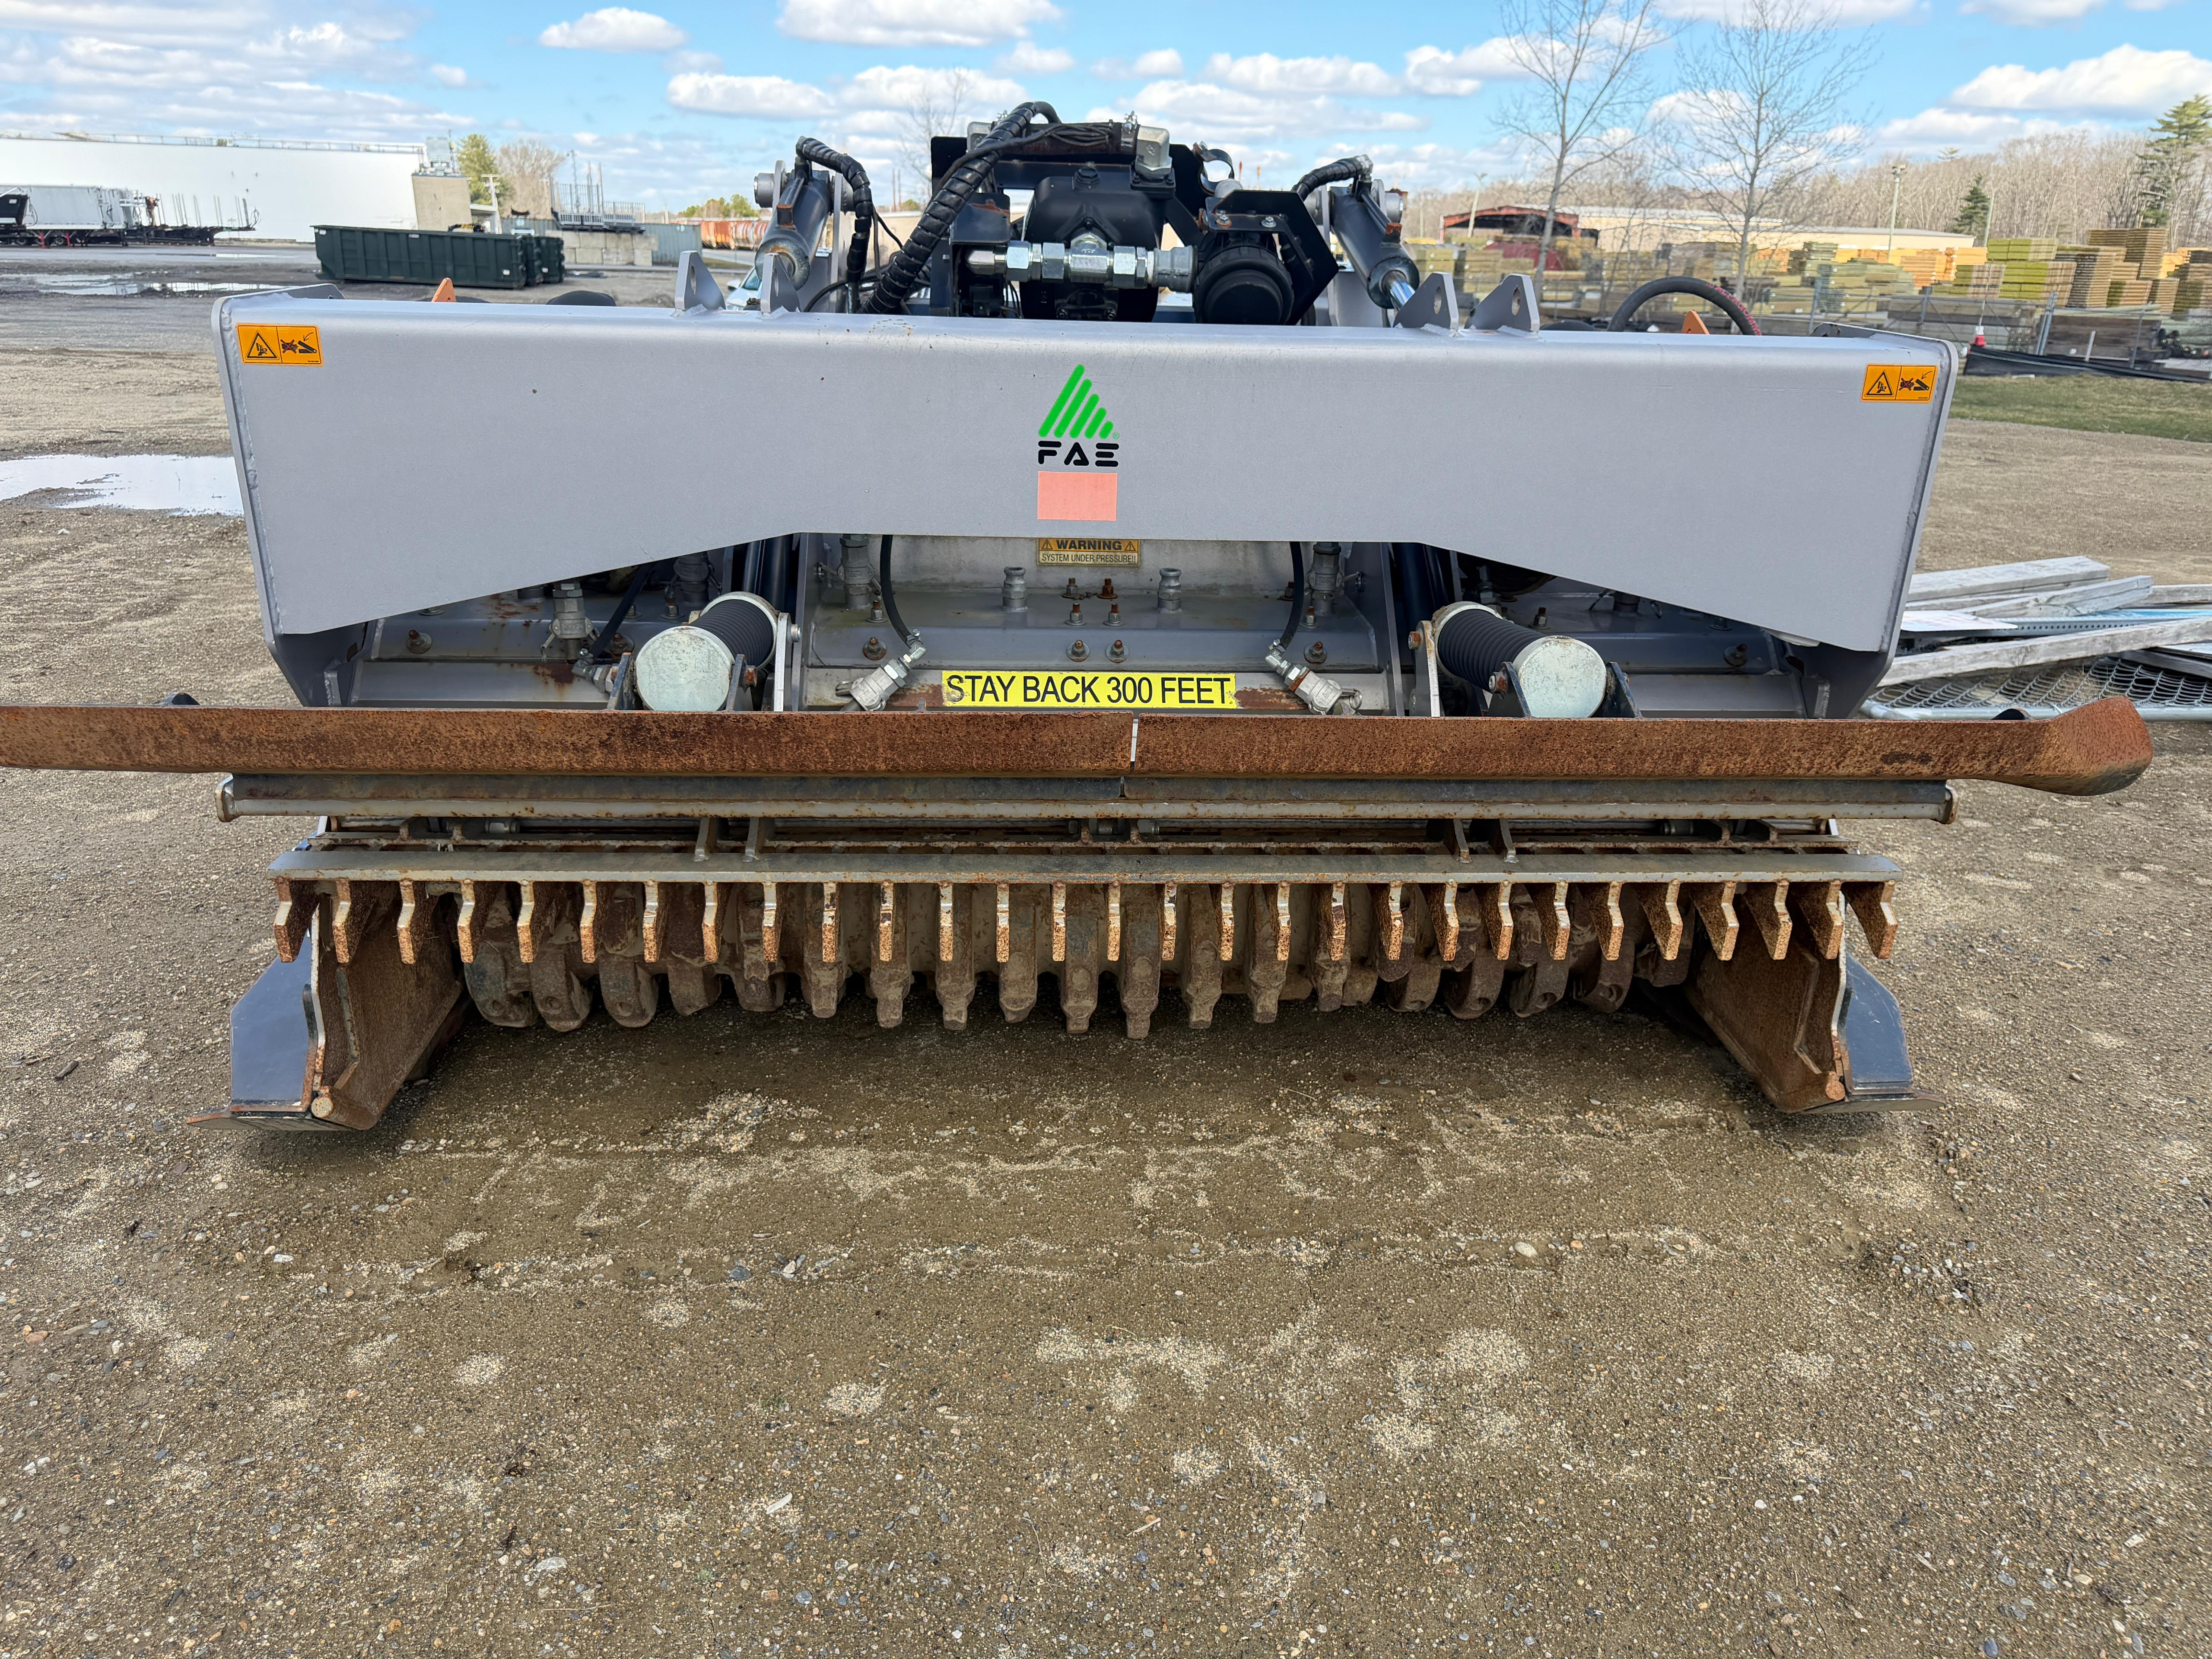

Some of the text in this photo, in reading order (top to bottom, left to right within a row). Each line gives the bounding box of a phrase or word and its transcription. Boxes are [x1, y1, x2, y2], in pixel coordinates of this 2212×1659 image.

[1038, 441, 1119, 467] FAE
[1057, 540, 1122, 550] WARNING
[947, 675, 1231, 704] STAY BACK 300 FEET
